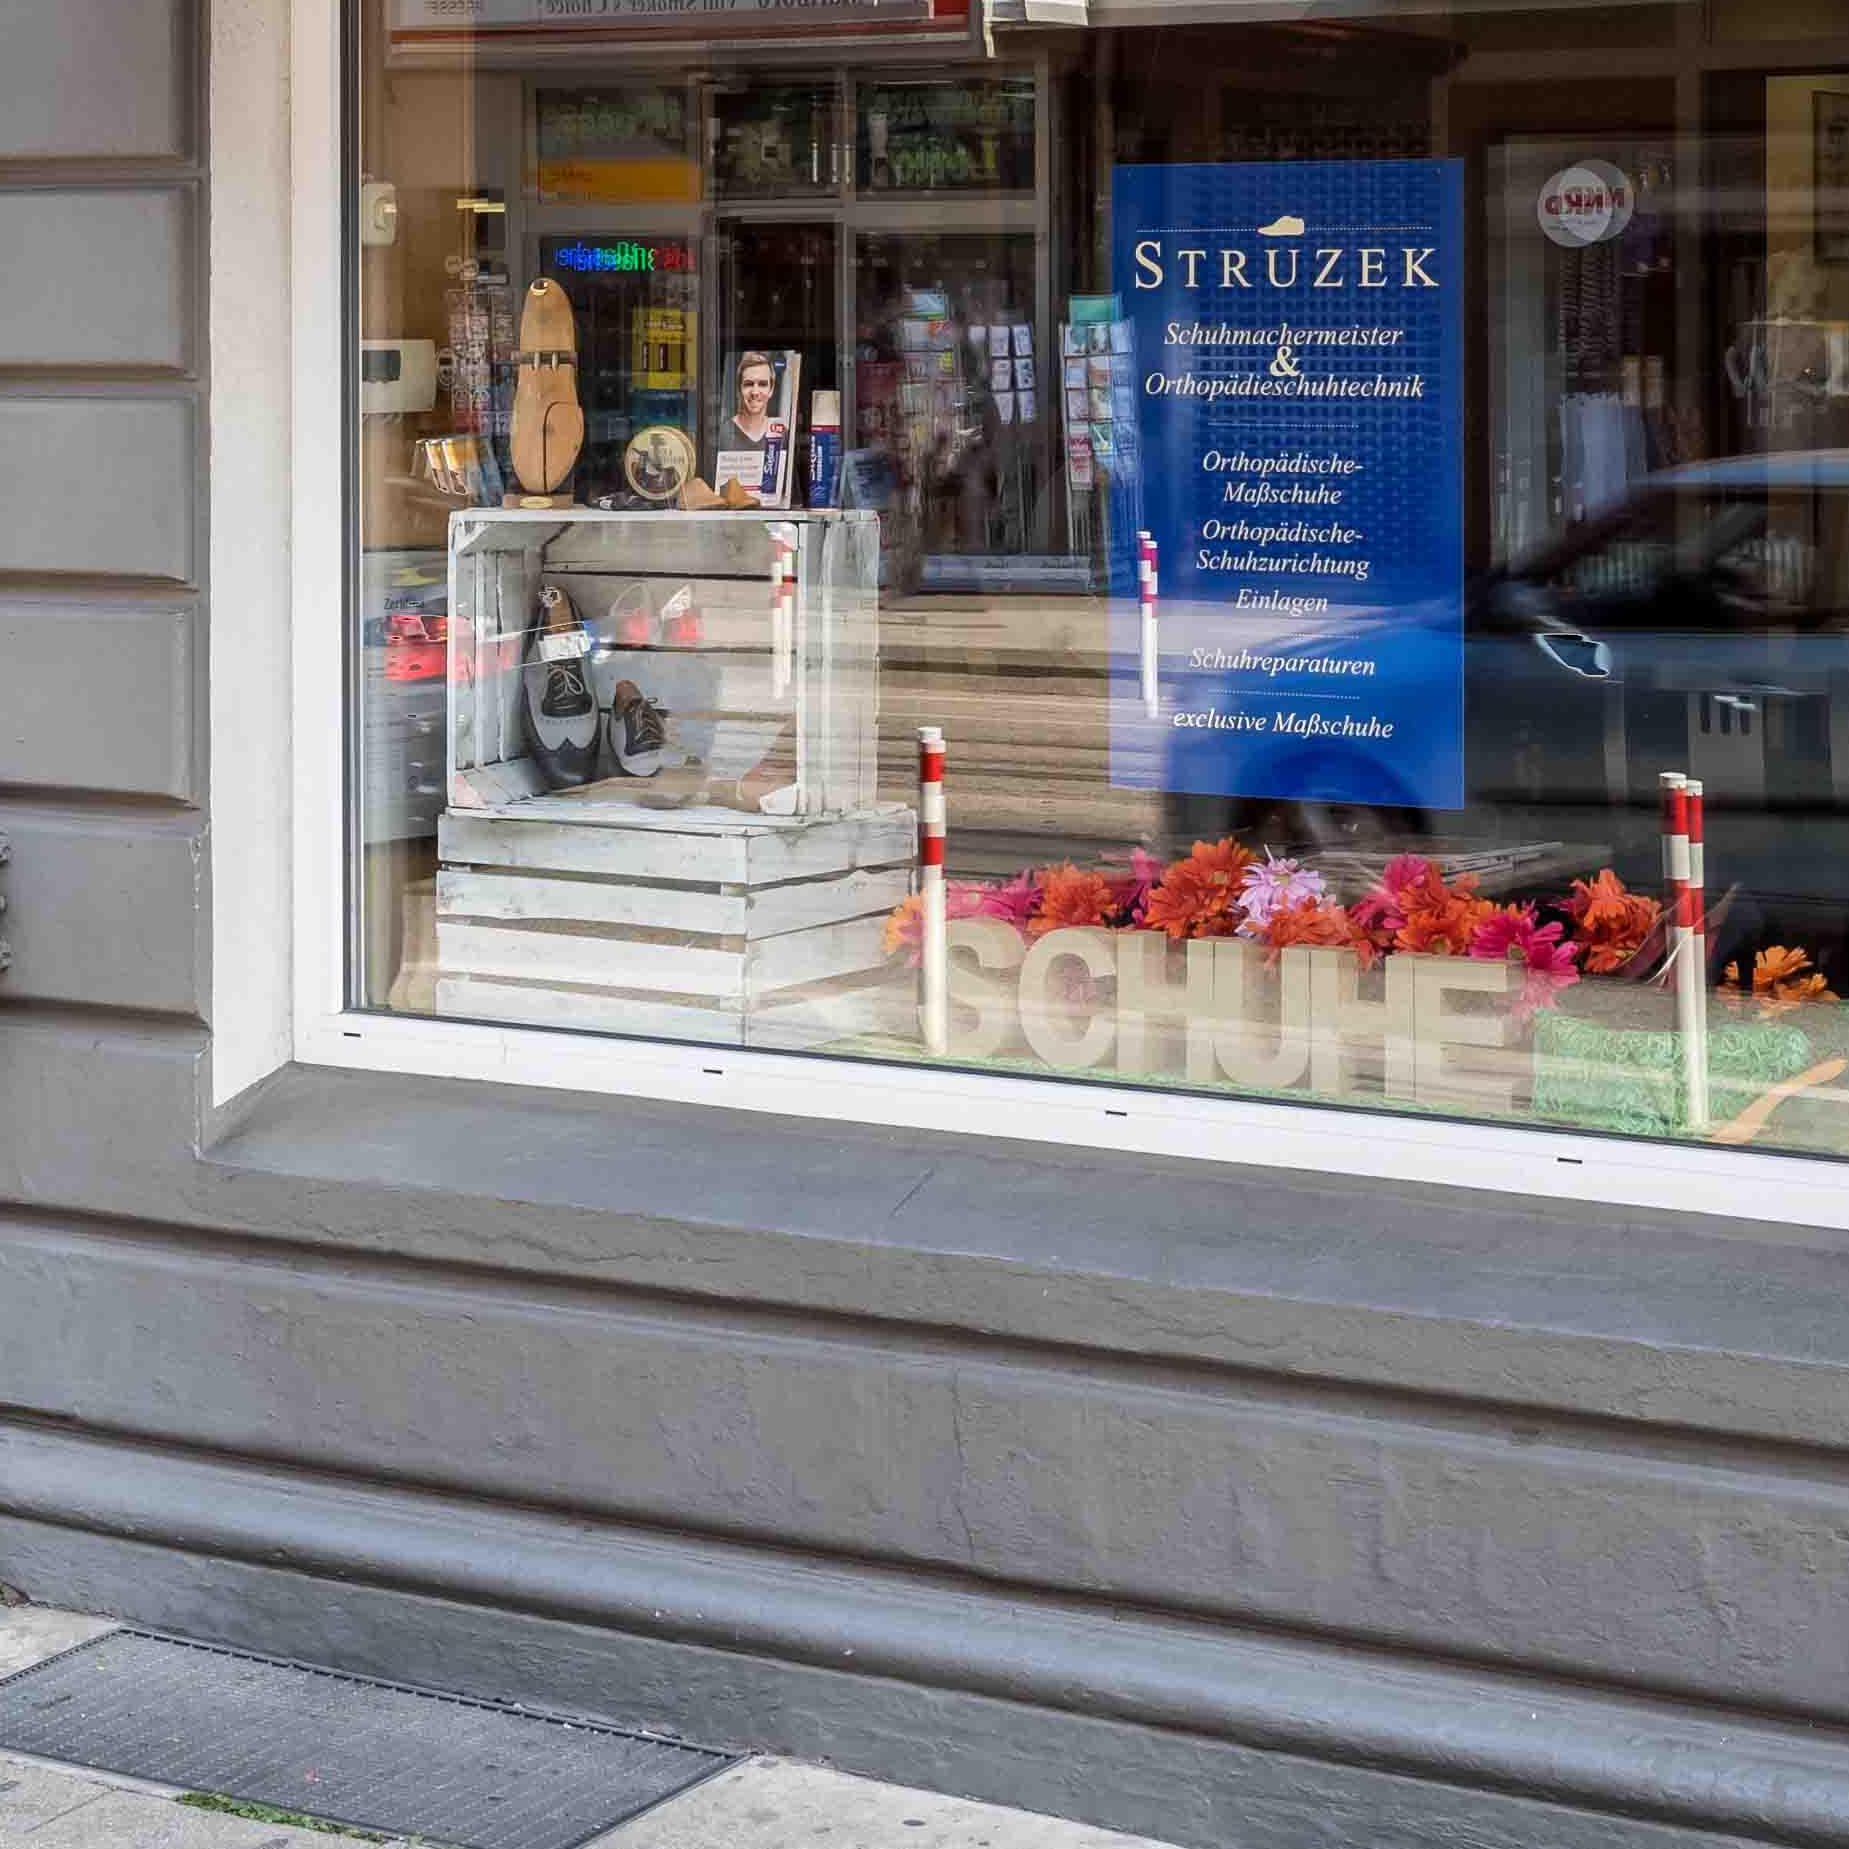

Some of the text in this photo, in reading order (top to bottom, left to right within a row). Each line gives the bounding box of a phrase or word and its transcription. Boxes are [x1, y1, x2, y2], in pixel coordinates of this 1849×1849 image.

[1135, 241, 1439, 289] STRUZEK
[1164, 321, 1403, 346] Schuhmachermeister
[1269, 345, 1301, 377] &
[1144, 372, 1425, 402] Orthopädieschuhtechnik
[1202, 450, 1364, 478] Orthopädische-
[1223, 481, 1342, 508] Maßschuhe
[1202, 519, 1364, 546] Orthopädische-
[1195, 549, 1370, 581] Schuhzurichtung
[1235, 588, 1329, 617] Einlagen
[1189, 647, 1376, 677] Schuhreparaturen
[1173, 708, 1394, 740] exclusive Maßschuhe
[917, 917, 1514, 1112] SCHUHE
